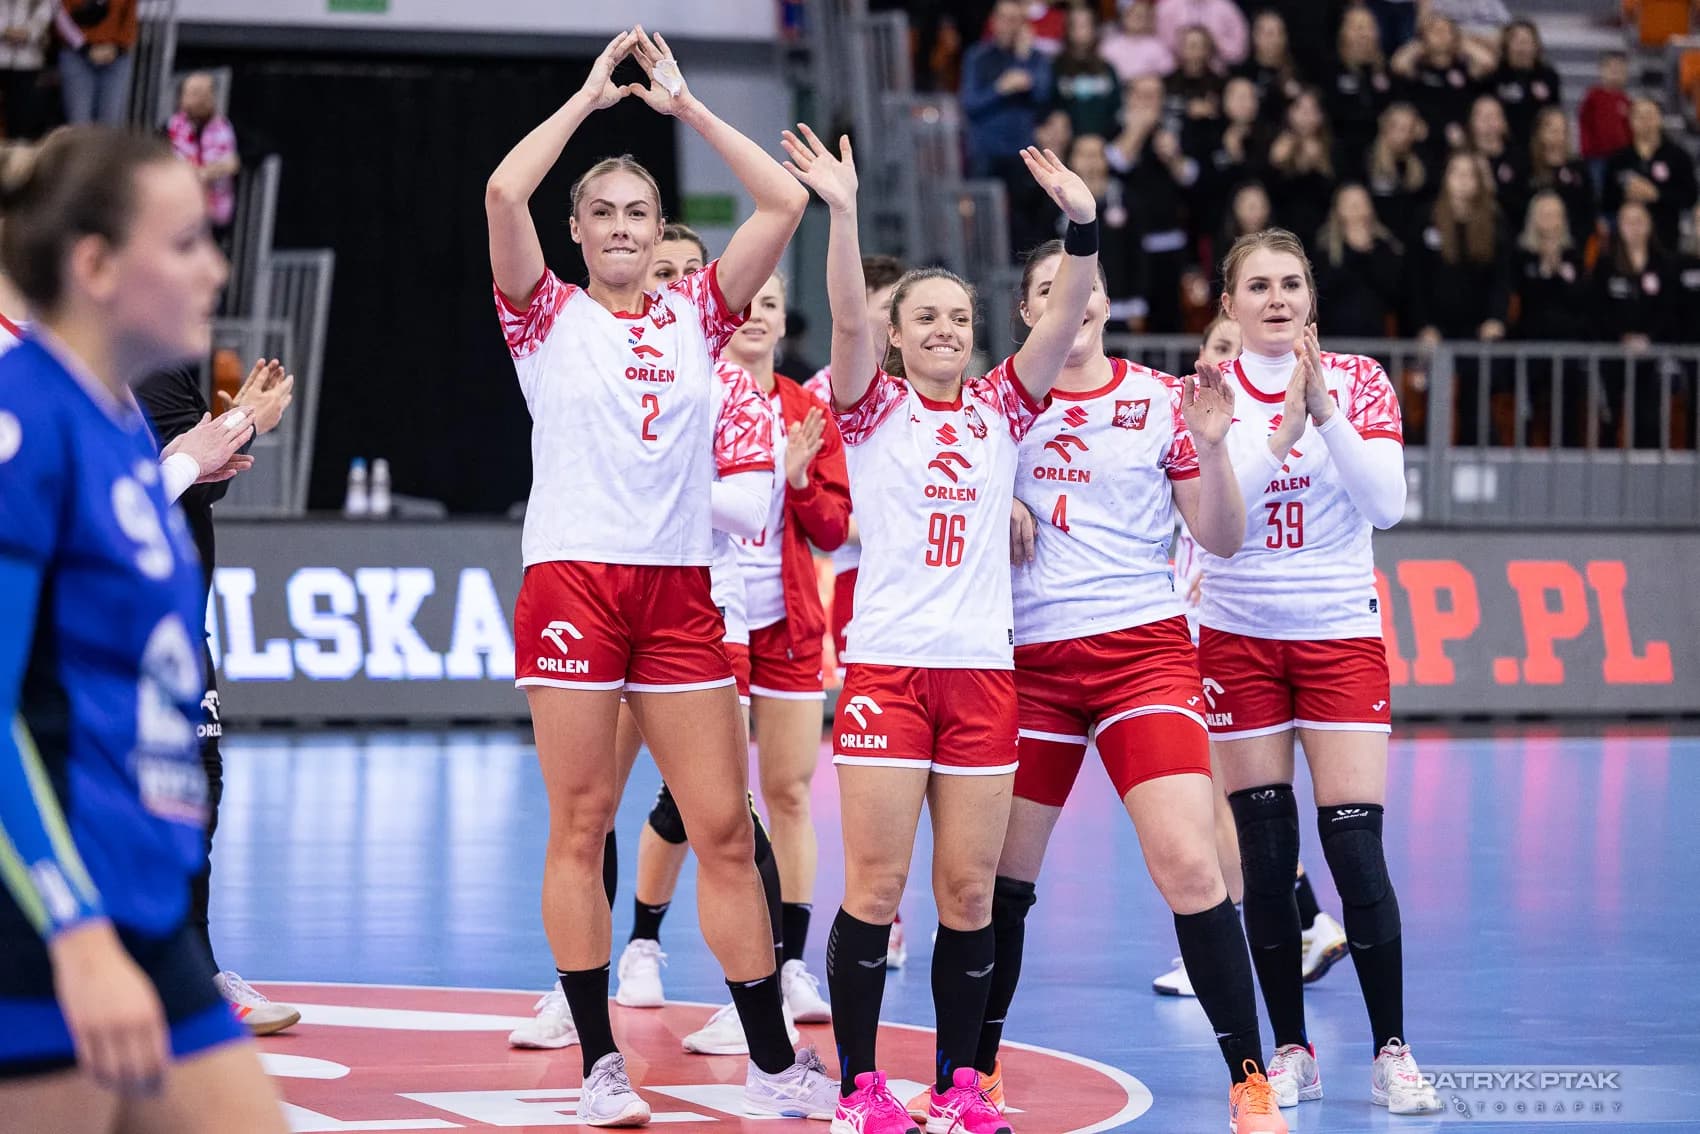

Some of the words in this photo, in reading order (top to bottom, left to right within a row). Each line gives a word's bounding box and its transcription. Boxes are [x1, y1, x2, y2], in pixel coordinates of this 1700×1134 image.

[625, 366, 675, 383] ORLEN
[641, 393, 660, 441] 2
[1033, 466, 1091, 484] ORLEN
[1264, 475, 1310, 494] RLEN
[924, 485, 976, 501] ORLEN
[1051, 494, 1070, 534] 4
[1264, 501, 1304, 549] 39
[925, 512, 966, 568] 96
[205, 567, 515, 680] LSKA
[537, 656, 590, 674] ORLEN
[840, 734, 888, 749] ORLEN
